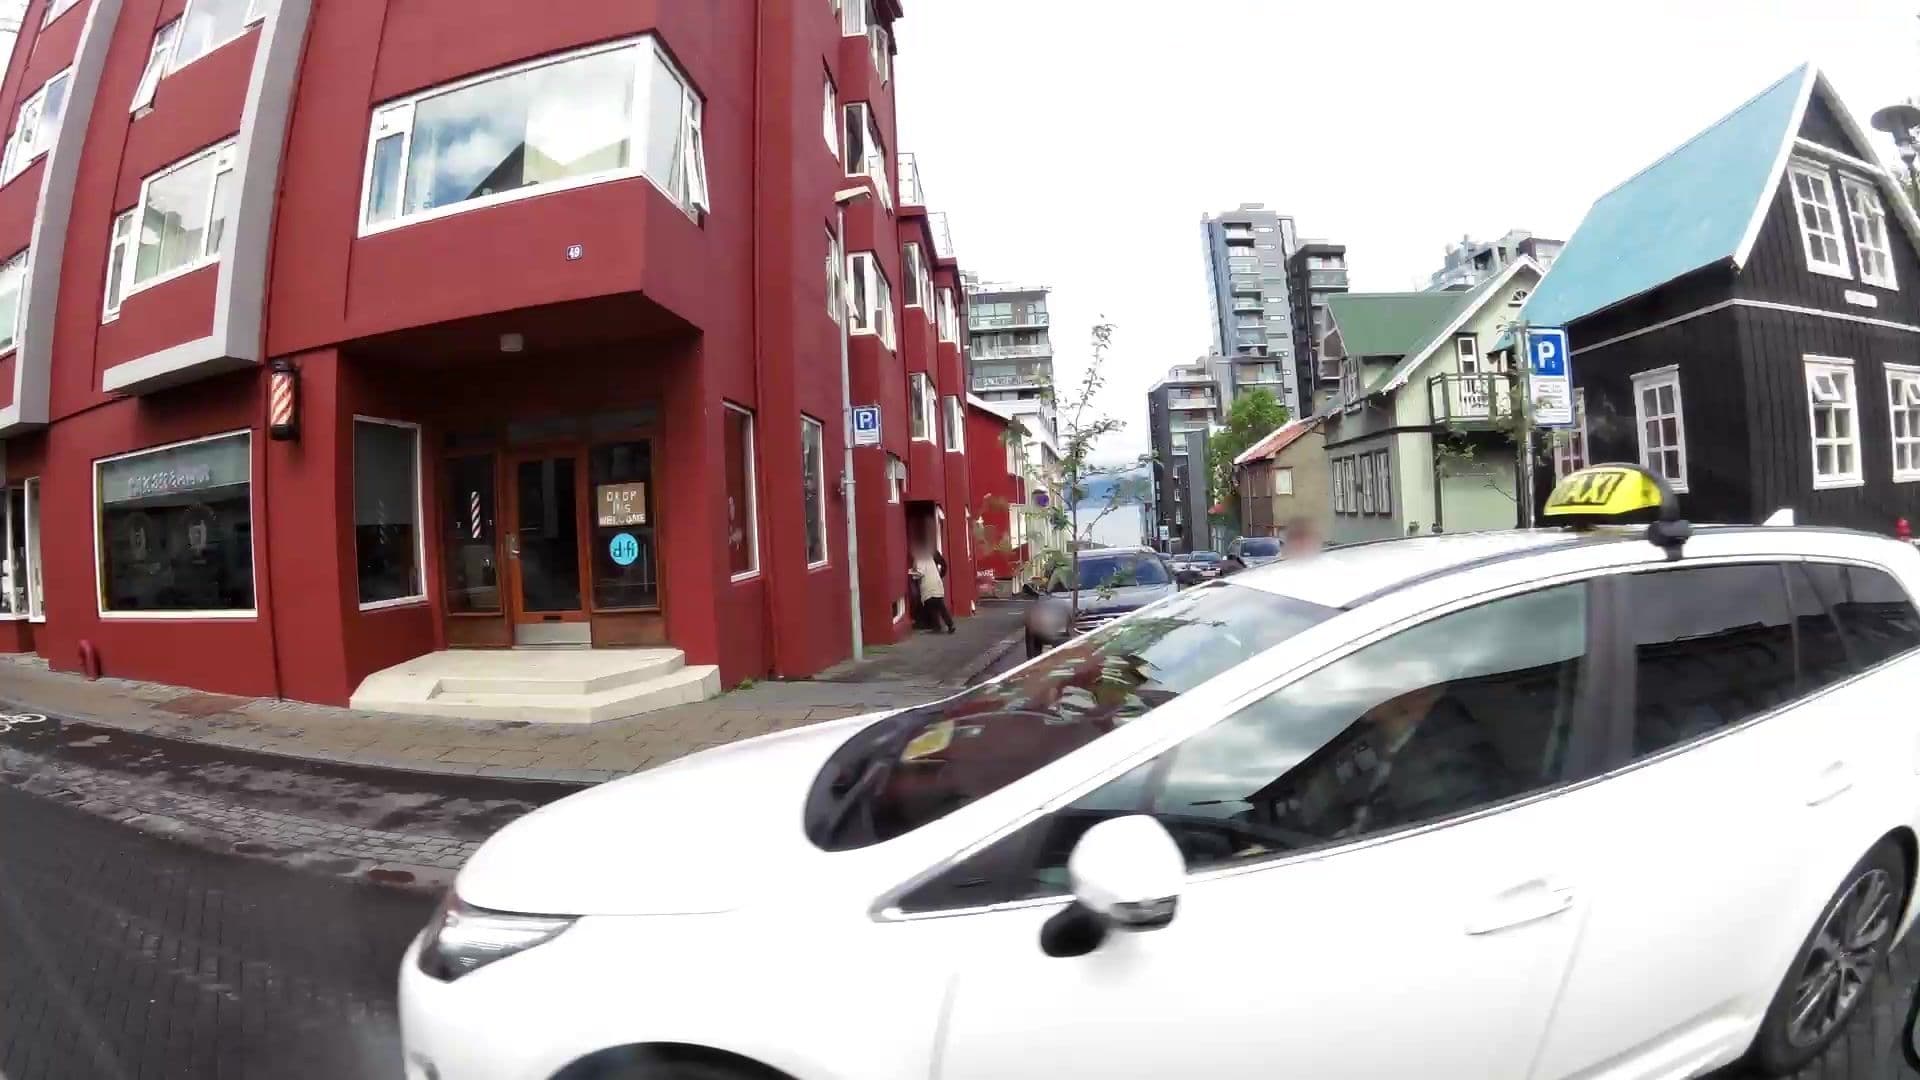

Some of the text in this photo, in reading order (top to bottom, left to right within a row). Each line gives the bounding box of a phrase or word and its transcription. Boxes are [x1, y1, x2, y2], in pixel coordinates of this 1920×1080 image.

[569, 247, 580, 258] 49
[1538, 341, 1555, 369] P
[860, 411, 873, 429] P
[1554, 473, 1622, 504] TAXI
